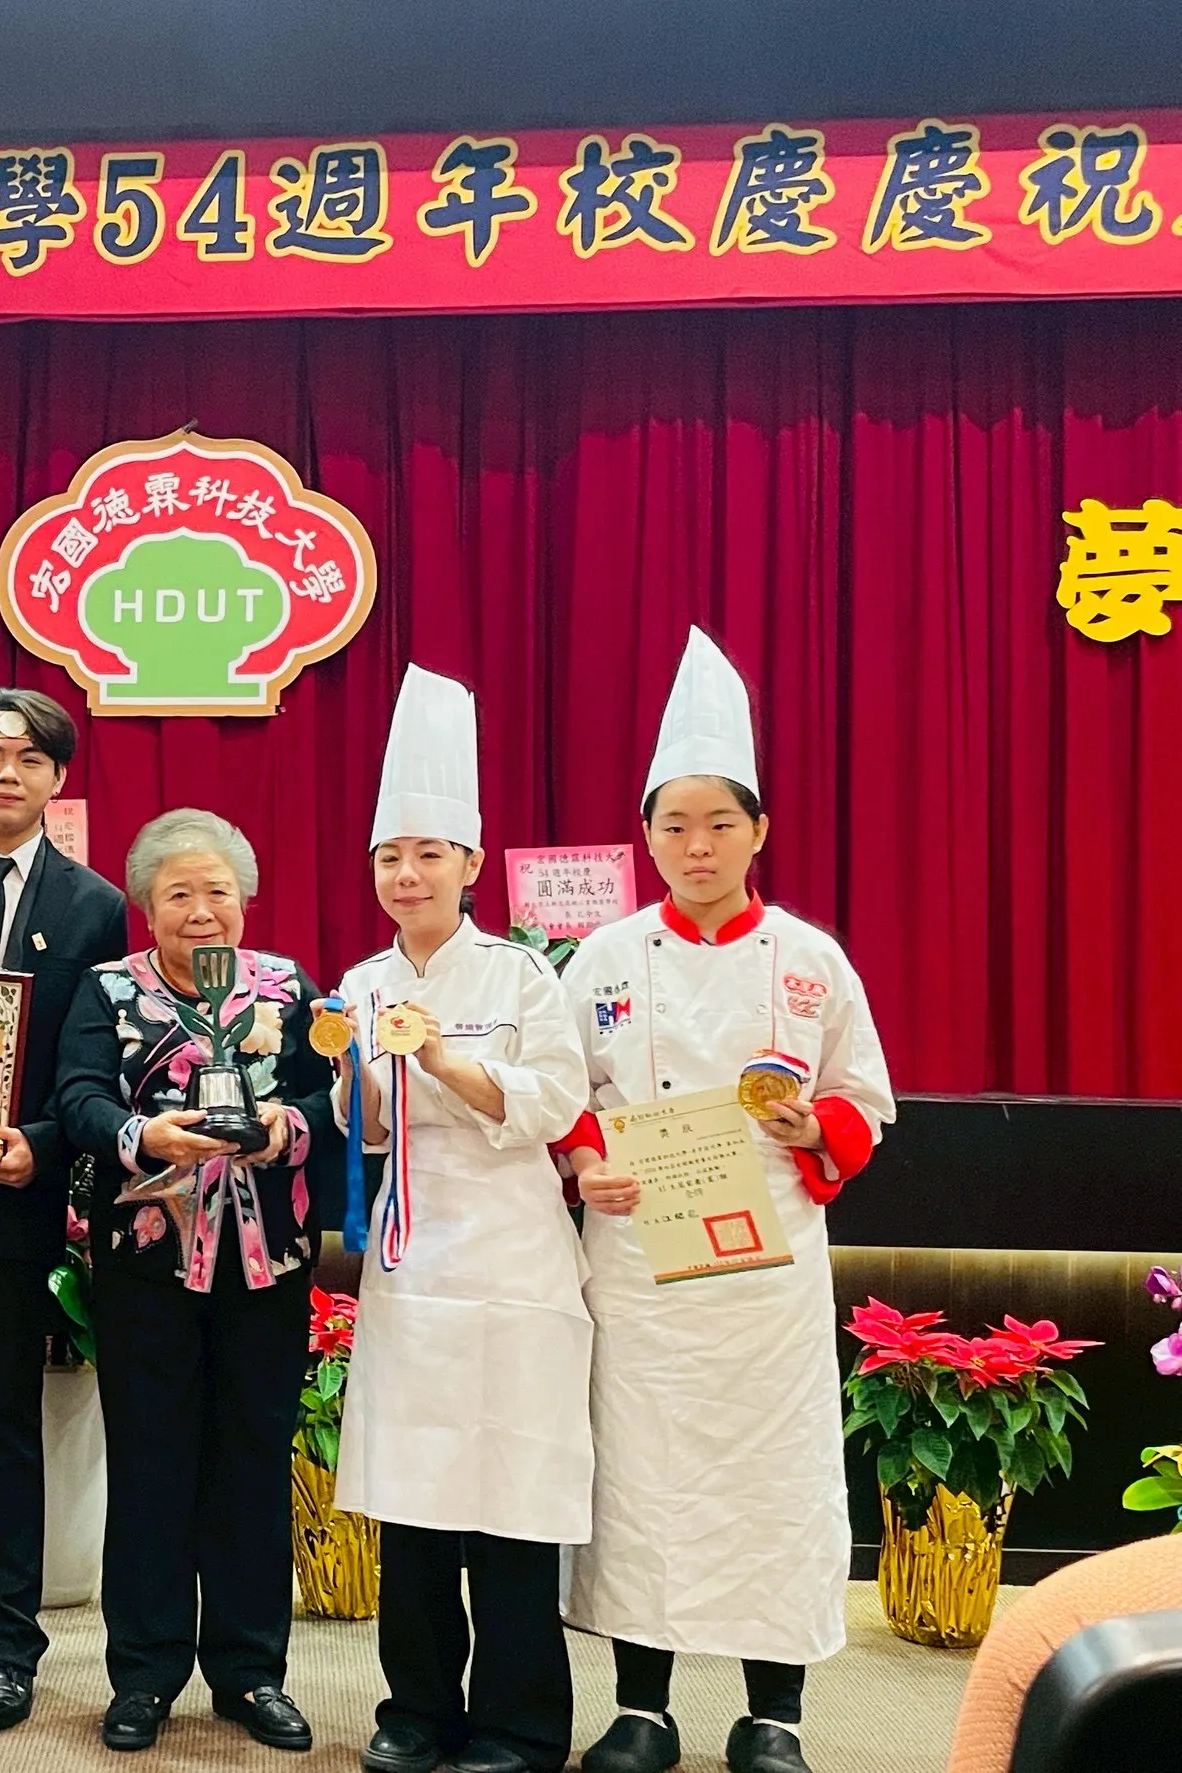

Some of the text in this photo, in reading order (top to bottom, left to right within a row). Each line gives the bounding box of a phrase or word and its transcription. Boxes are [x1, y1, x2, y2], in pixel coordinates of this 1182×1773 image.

[29, 472, 347, 613] 宏國德霖科技大學
[1056, 498, 1182, 643] 夢
[113, 588, 264, 623] HDUT
[537, 877, 615, 898] 圓滿成功
